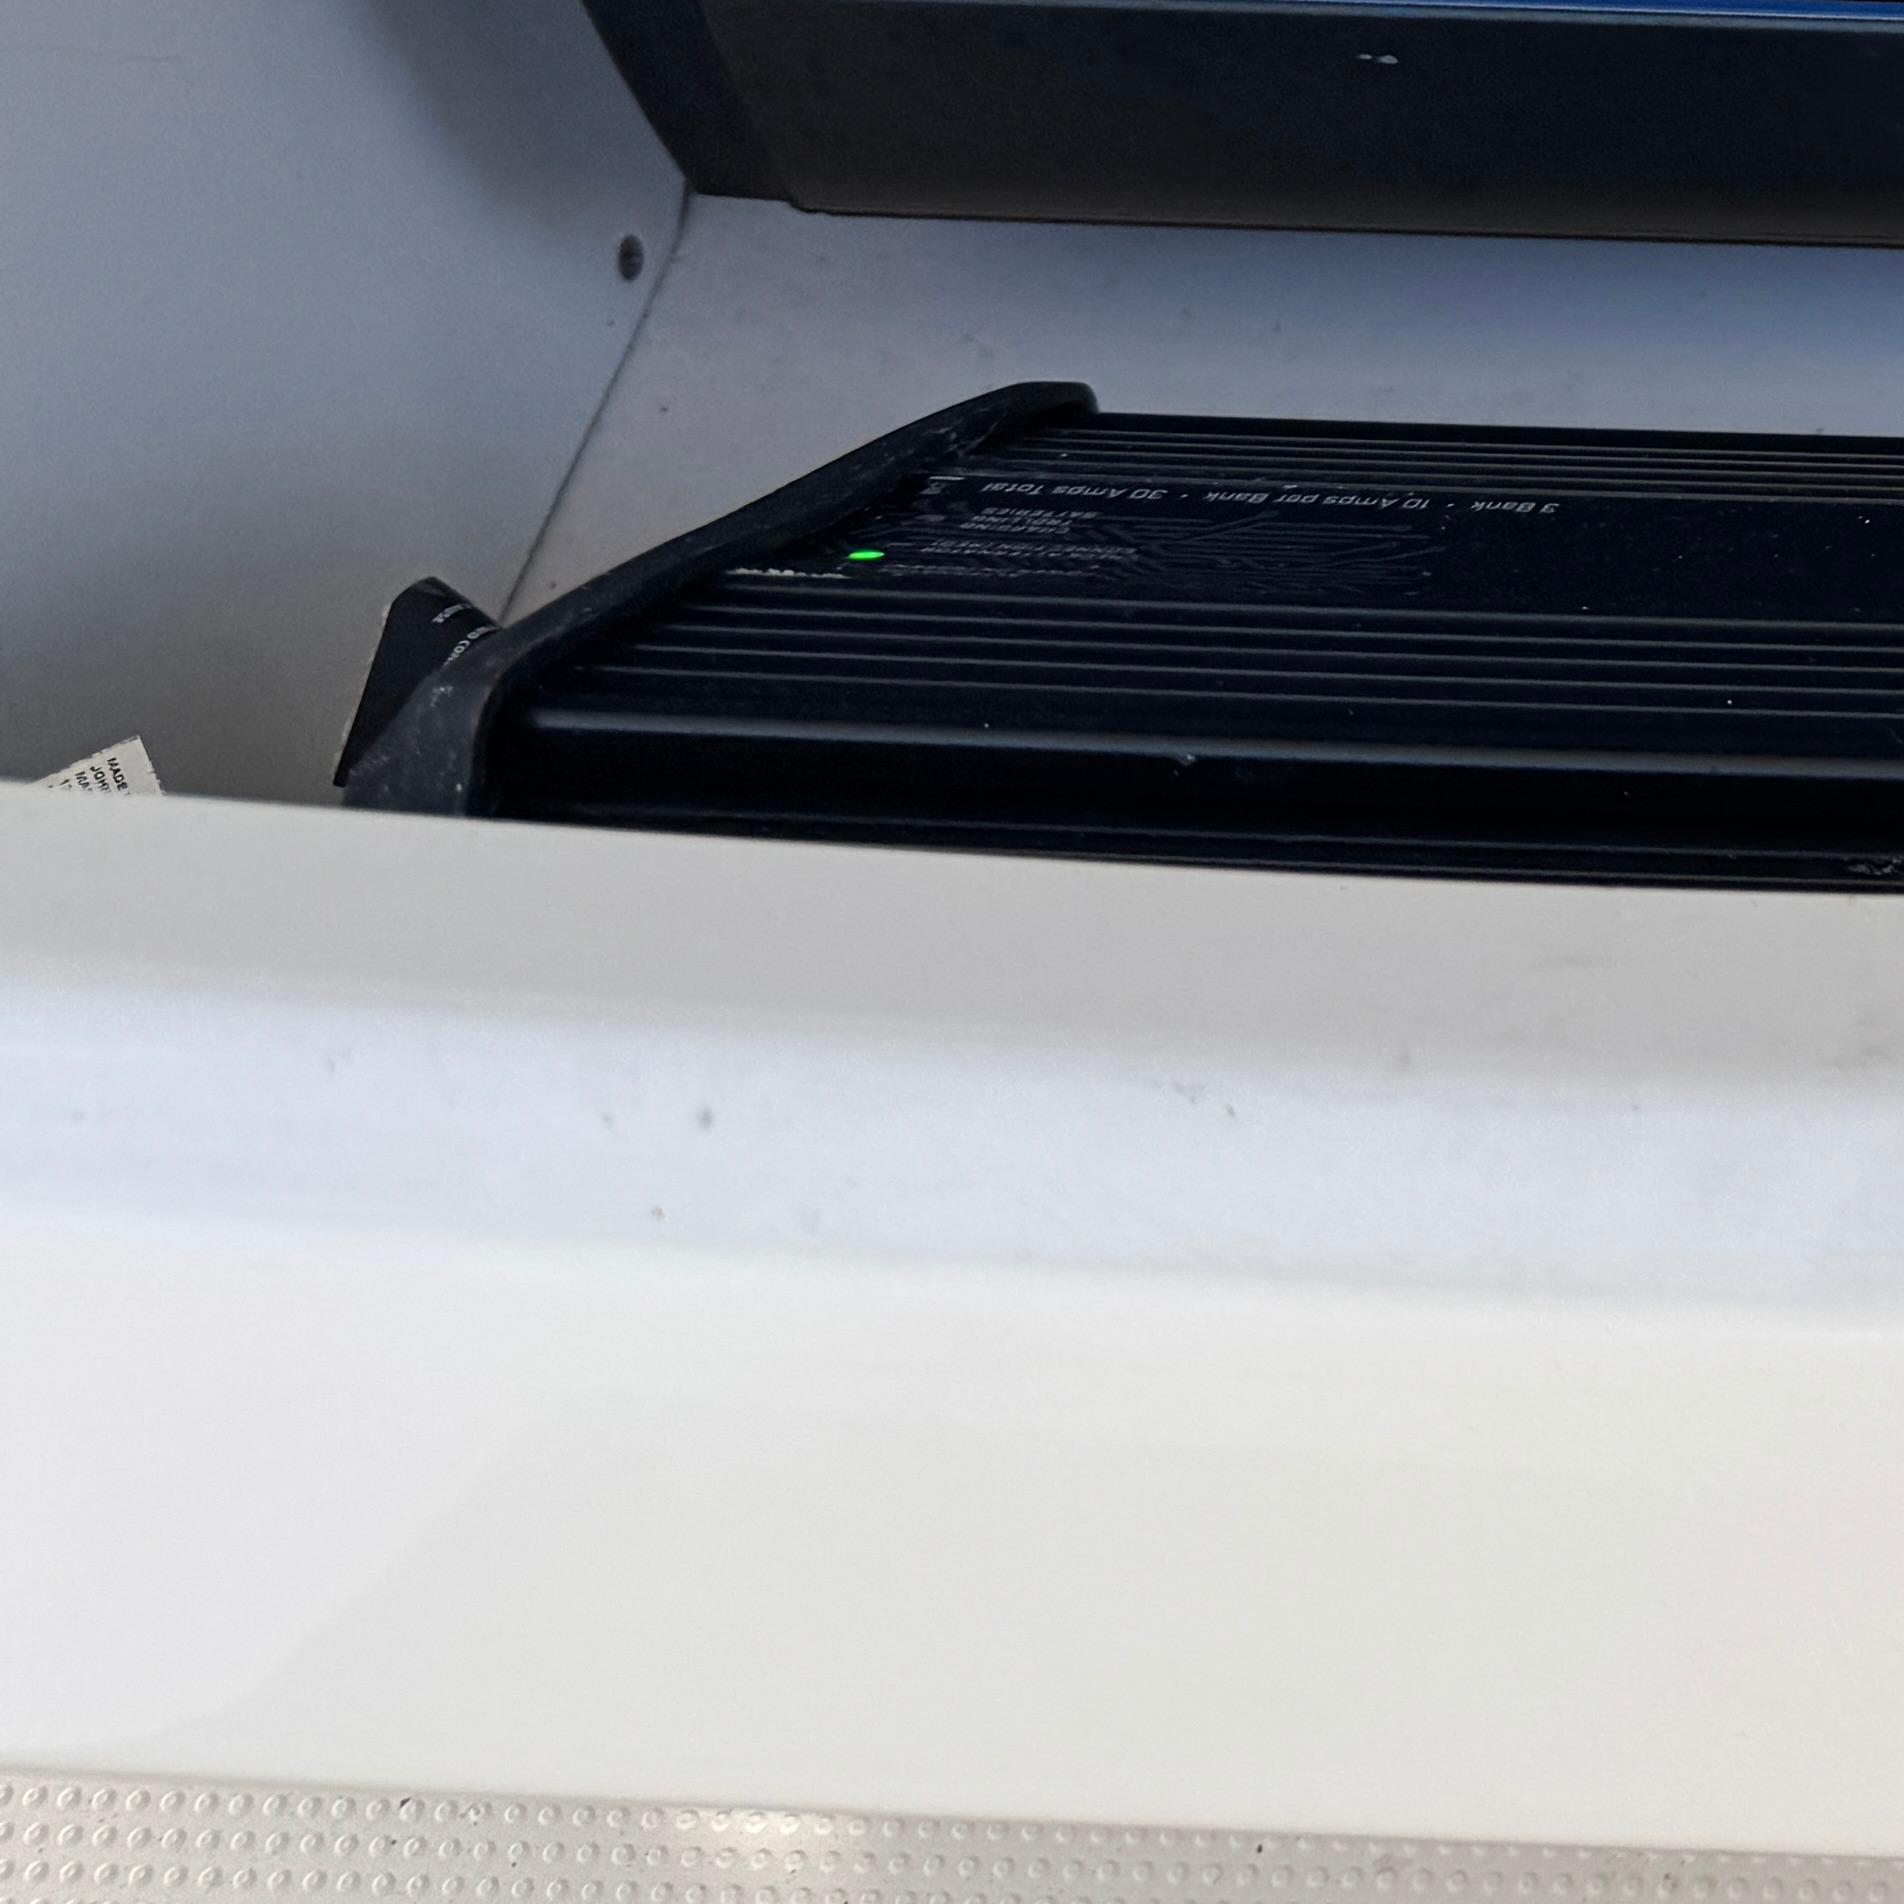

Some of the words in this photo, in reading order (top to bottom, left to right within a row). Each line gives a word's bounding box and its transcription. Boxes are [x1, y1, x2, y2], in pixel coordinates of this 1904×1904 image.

[981, 482, 1044, 496] Total
[1052, 485, 1126, 499] Amps
[1126, 488, 1168, 500] 30
[1203, 491, 1271, 504] Bank
[1322, 495, 1399, 509] Amps
[1400, 498, 1431, 510] 10
[1470, 500, 1534, 514] Bank
[1539, 502, 1560, 513] 3
[107, 757, 128, 791] MADE
